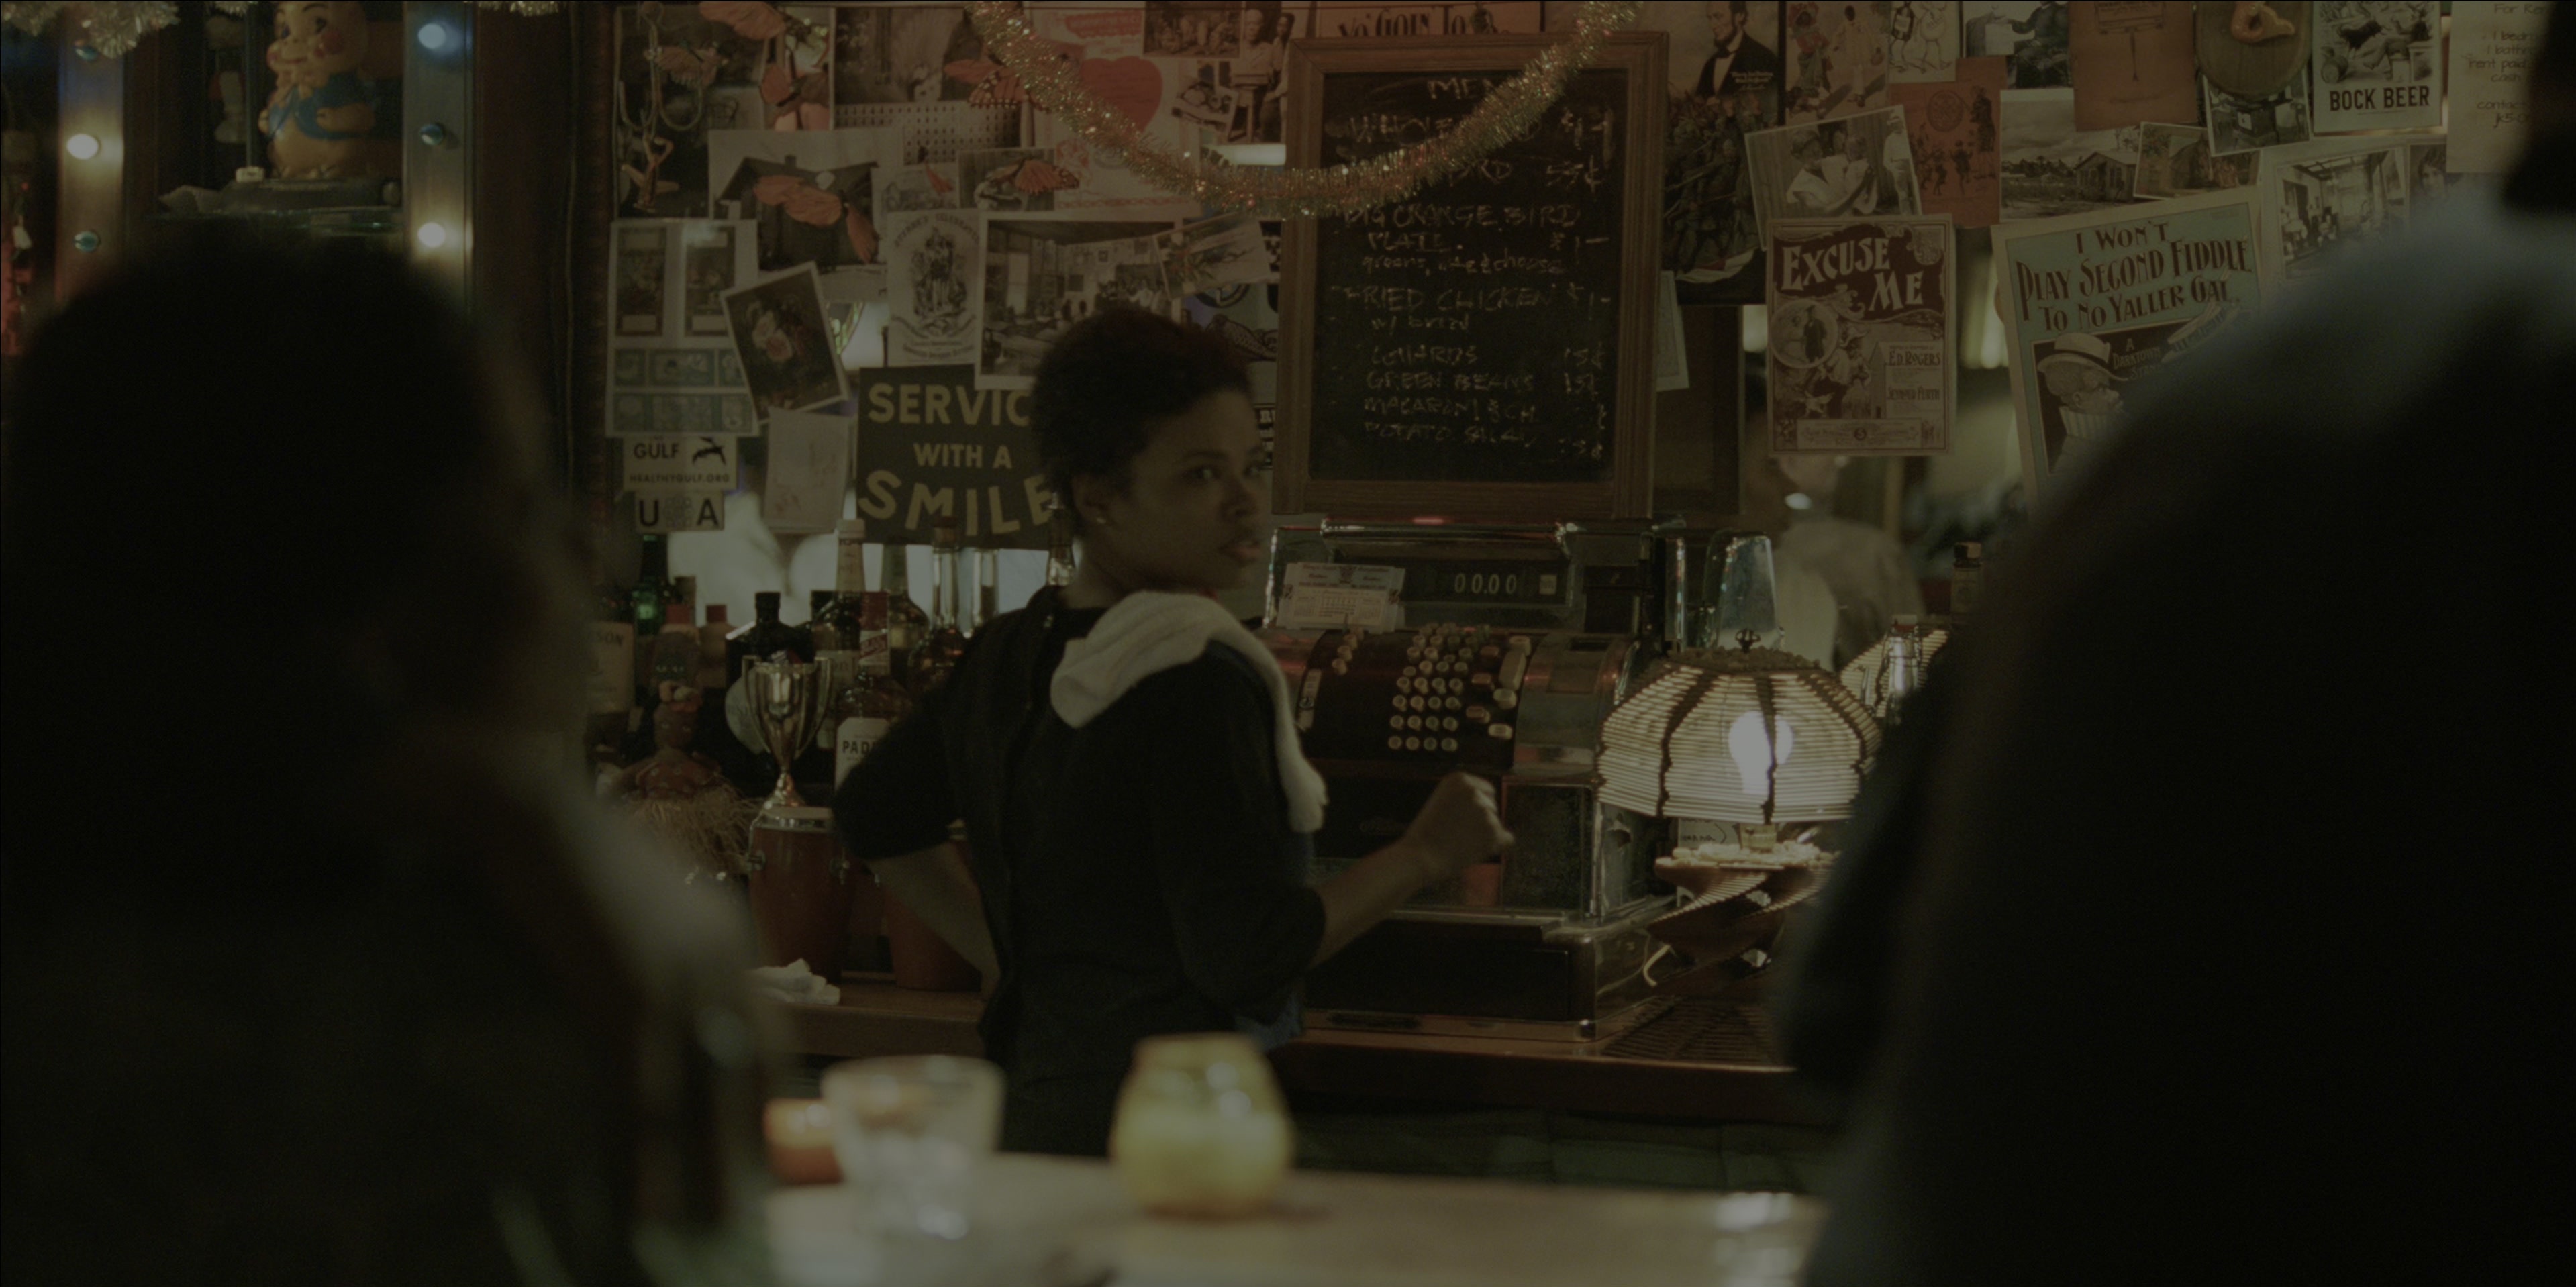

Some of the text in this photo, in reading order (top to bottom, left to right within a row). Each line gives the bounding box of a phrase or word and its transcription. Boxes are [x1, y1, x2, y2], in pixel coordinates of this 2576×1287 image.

[1427, 76, 1494, 101] ME
[2329, 85, 2430, 111] BOCK BEER
[1503, 203, 1581, 229] BIRD
[2076, 221, 2169, 254] I WON'T
[1781, 237, 1891, 291] EXCUSE
[2016, 235, 2252, 321] PLAY SECOND FIDDLE
[1868, 270, 1925, 312] ME
[2042, 306, 2069, 331] TO
[2078, 301, 2107, 329] NO
[2108, 284, 2185, 323] YALLER
[868, 382, 1032, 427] SERVIC
[634, 443, 679, 459] GULF
[913, 442, 1013, 469] WITH A
[858, 469, 1054, 536] SMILE
